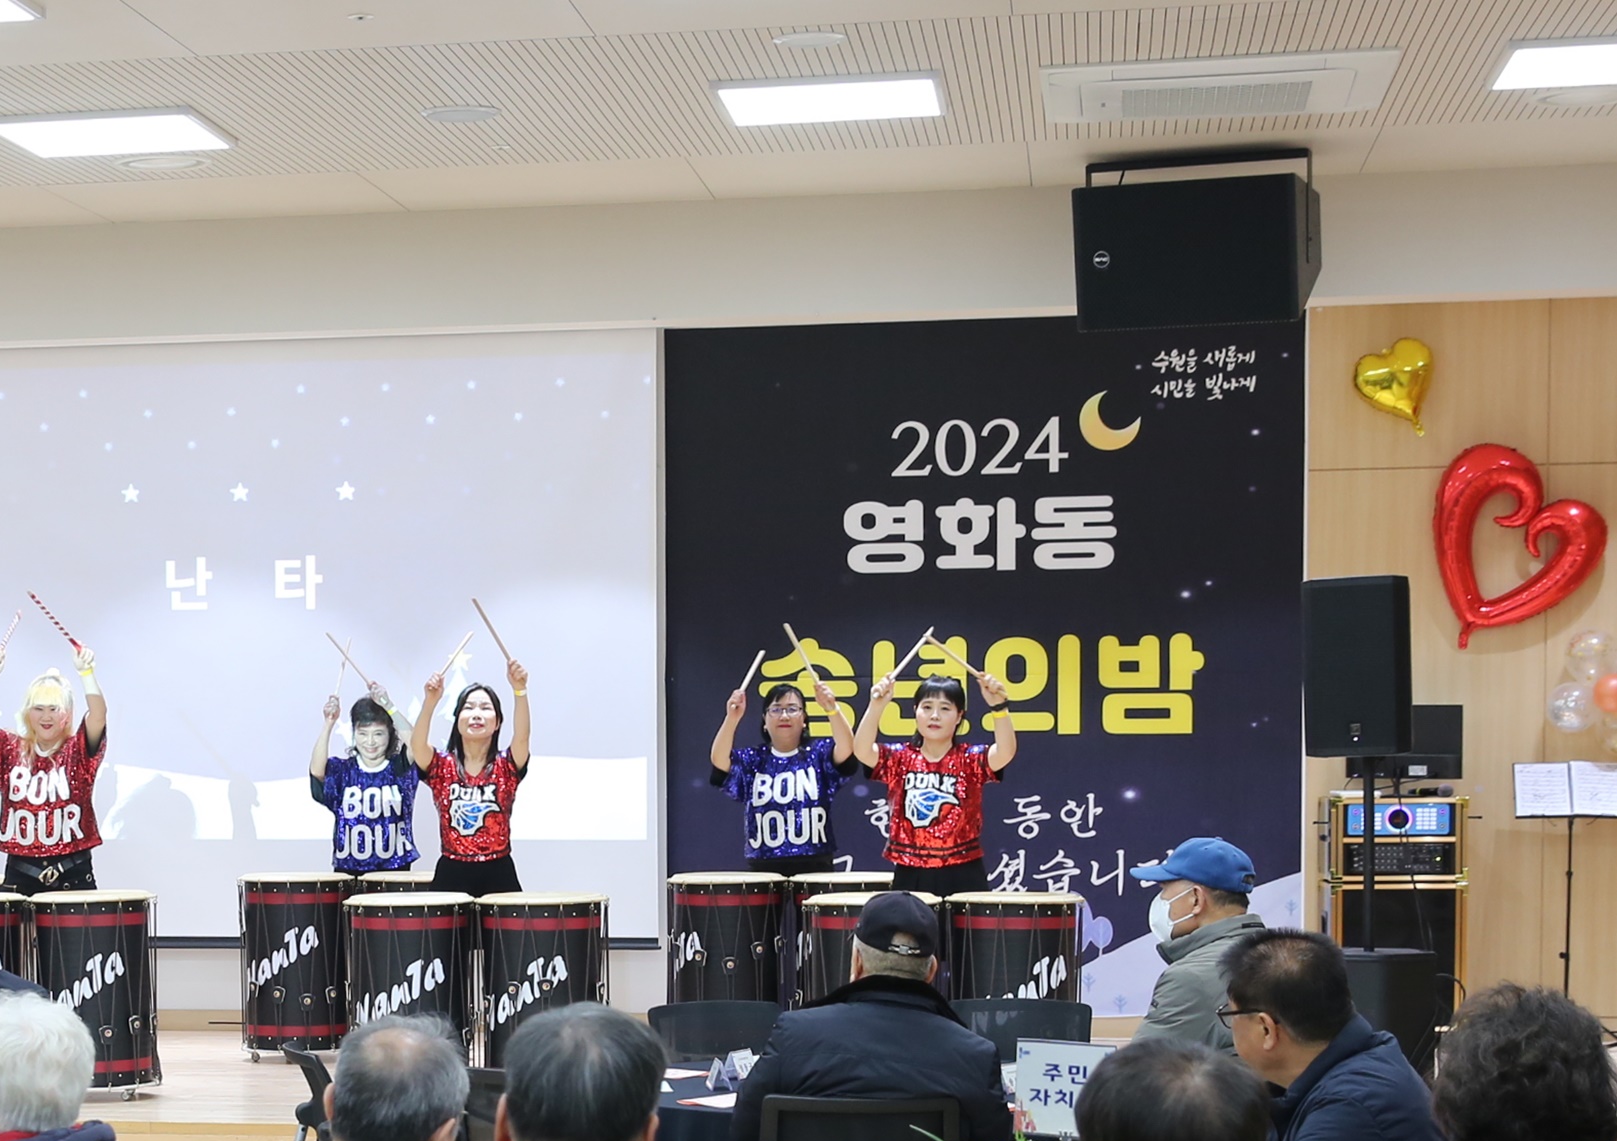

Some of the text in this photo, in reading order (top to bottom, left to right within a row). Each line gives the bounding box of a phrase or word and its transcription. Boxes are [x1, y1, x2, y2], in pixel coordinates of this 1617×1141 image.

[1151, 345, 1256, 374] 수원을 새롭게
[1150, 372, 1257, 400] 시민을 빛나게
[891, 415, 1069, 478] 2024
[843, 495, 1118, 574] 영화동
[8, 765, 70, 805] BON
[752, 766, 819, 807] BON
[904, 772, 958, 793] DUNK
[342, 785, 402, 820] BON
[1003, 792, 1103, 839] 동안
[336, 821, 412, 860] JOUR
[749, 807, 827, 849] JOUR
[1042, 1062, 1088, 1085] 주민
